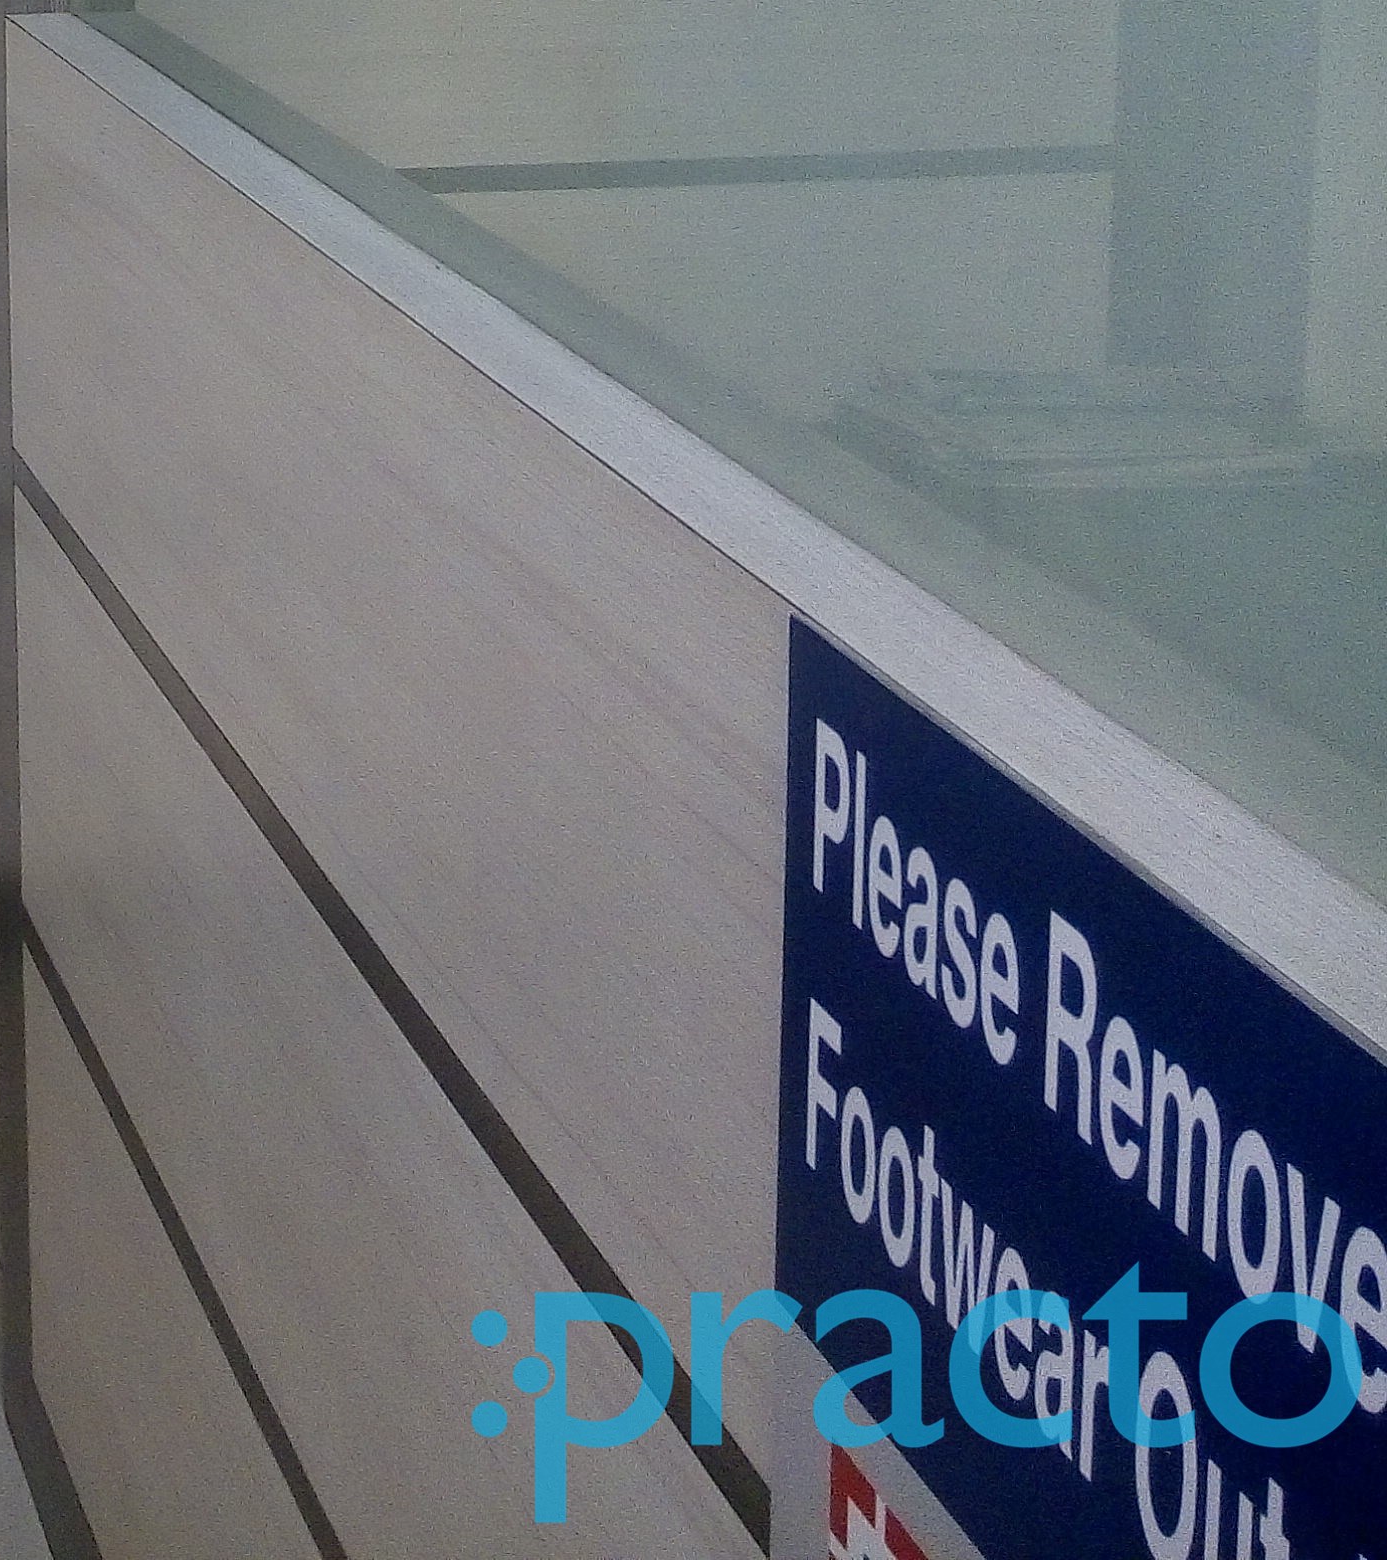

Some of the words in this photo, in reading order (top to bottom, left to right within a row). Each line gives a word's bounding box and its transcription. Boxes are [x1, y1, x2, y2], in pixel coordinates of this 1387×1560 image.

[804, 998, 1109, 1482] Footwear
[1135, 1351, 1291, 1560] Out
[813, 719, 1021, 1066] Please
[1043, 911, 1387, 1413] Remove
